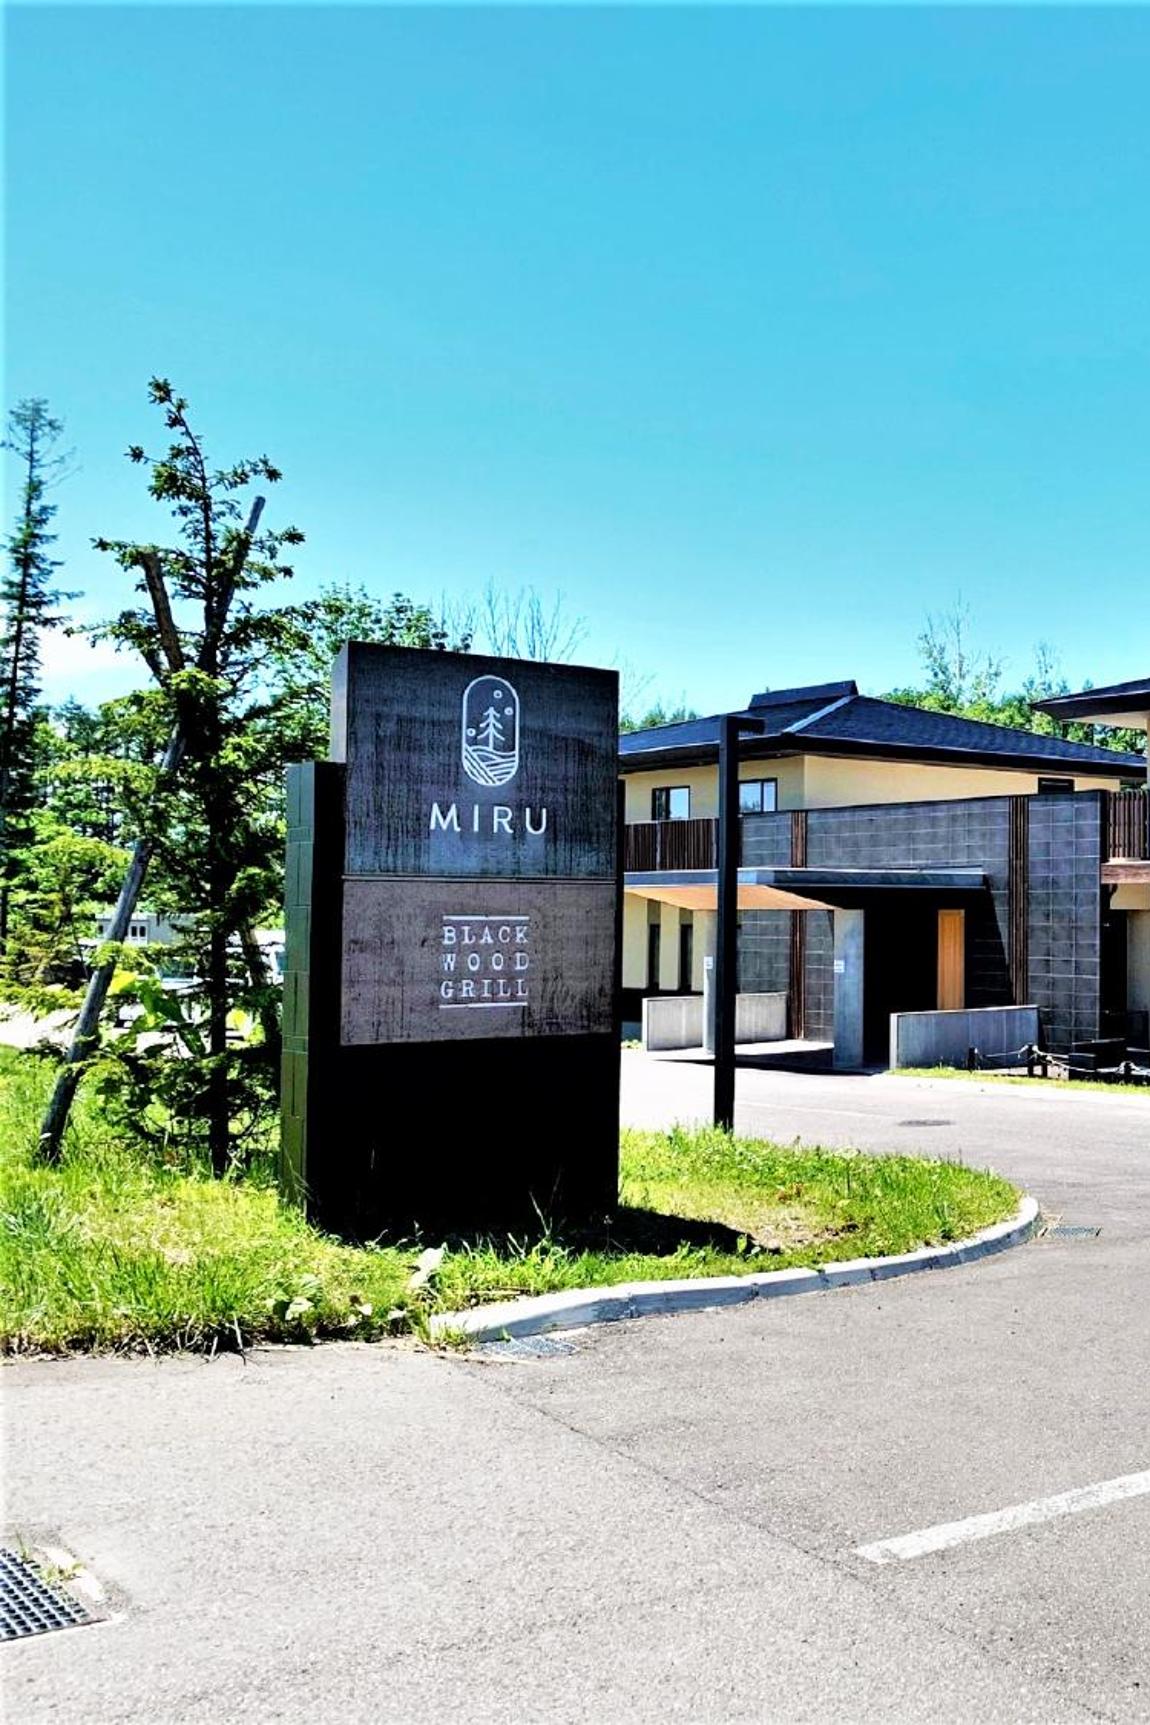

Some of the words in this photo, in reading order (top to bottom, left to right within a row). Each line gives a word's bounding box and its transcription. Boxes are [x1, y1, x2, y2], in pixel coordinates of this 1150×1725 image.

[429, 802, 548, 836] MIRU
[441, 925, 529, 945] BLACK
[442, 952, 530, 972] WOOD
[440, 979, 529, 999] GRILL
